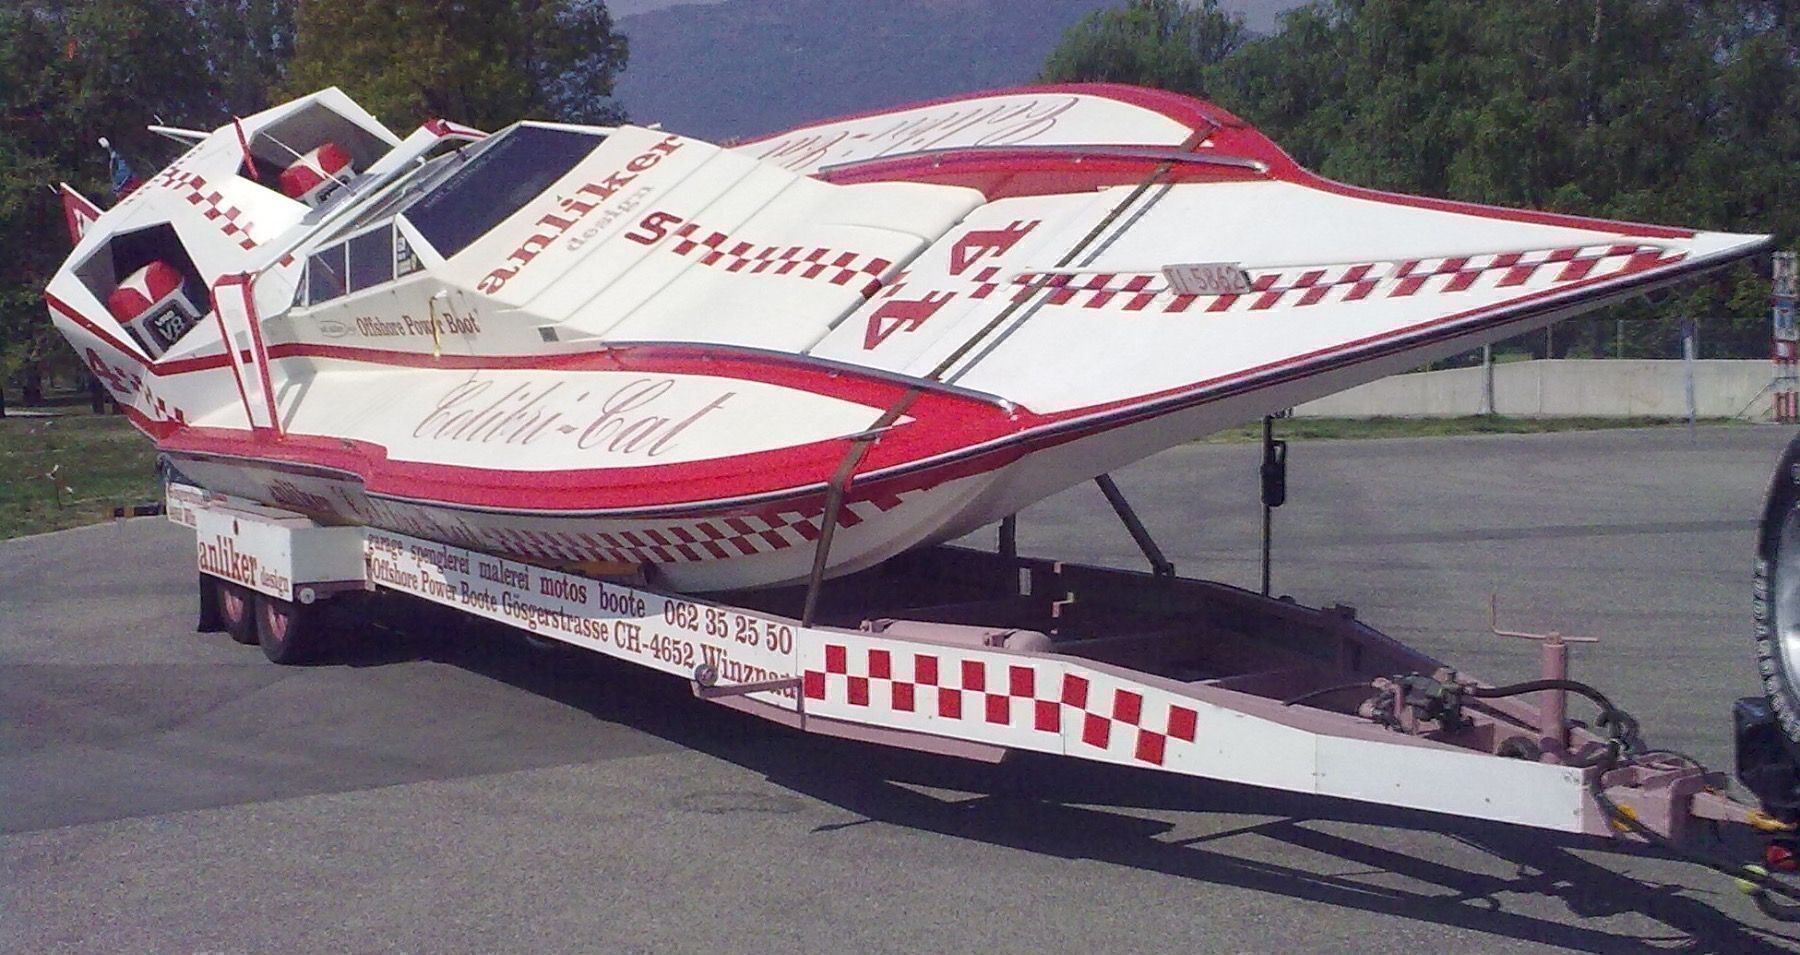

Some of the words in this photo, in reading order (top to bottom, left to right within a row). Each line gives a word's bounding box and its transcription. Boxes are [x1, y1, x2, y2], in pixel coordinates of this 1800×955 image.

[476, 135, 685, 295] anliker
[566, 185, 656, 252] design
[355, 315, 405, 337] Offshore
[403, 315, 444, 336] Powr
[199, 534, 258, 588] anliker
[261, 565, 290, 598] design
[367, 533, 404, 561] garage
[411, 543, 470, 576] spenglerei
[478, 559, 530, 591] malerei
[540, 574, 588, 605] motos
[599, 581, 646, 619] boote
[664, 599, 700, 632] 062
[705, 608, 729, 639] 35
[735, 615, 760, 647] 25
[766, 622, 793, 656] 50
[372, 557, 418, 591] Offshore
[421, 569, 458, 602] Power
[460, 580, 498, 613] Boote
[502, 590, 610, 643] Gösgerstrasse
[614, 620, 696, 670] CH-4652
